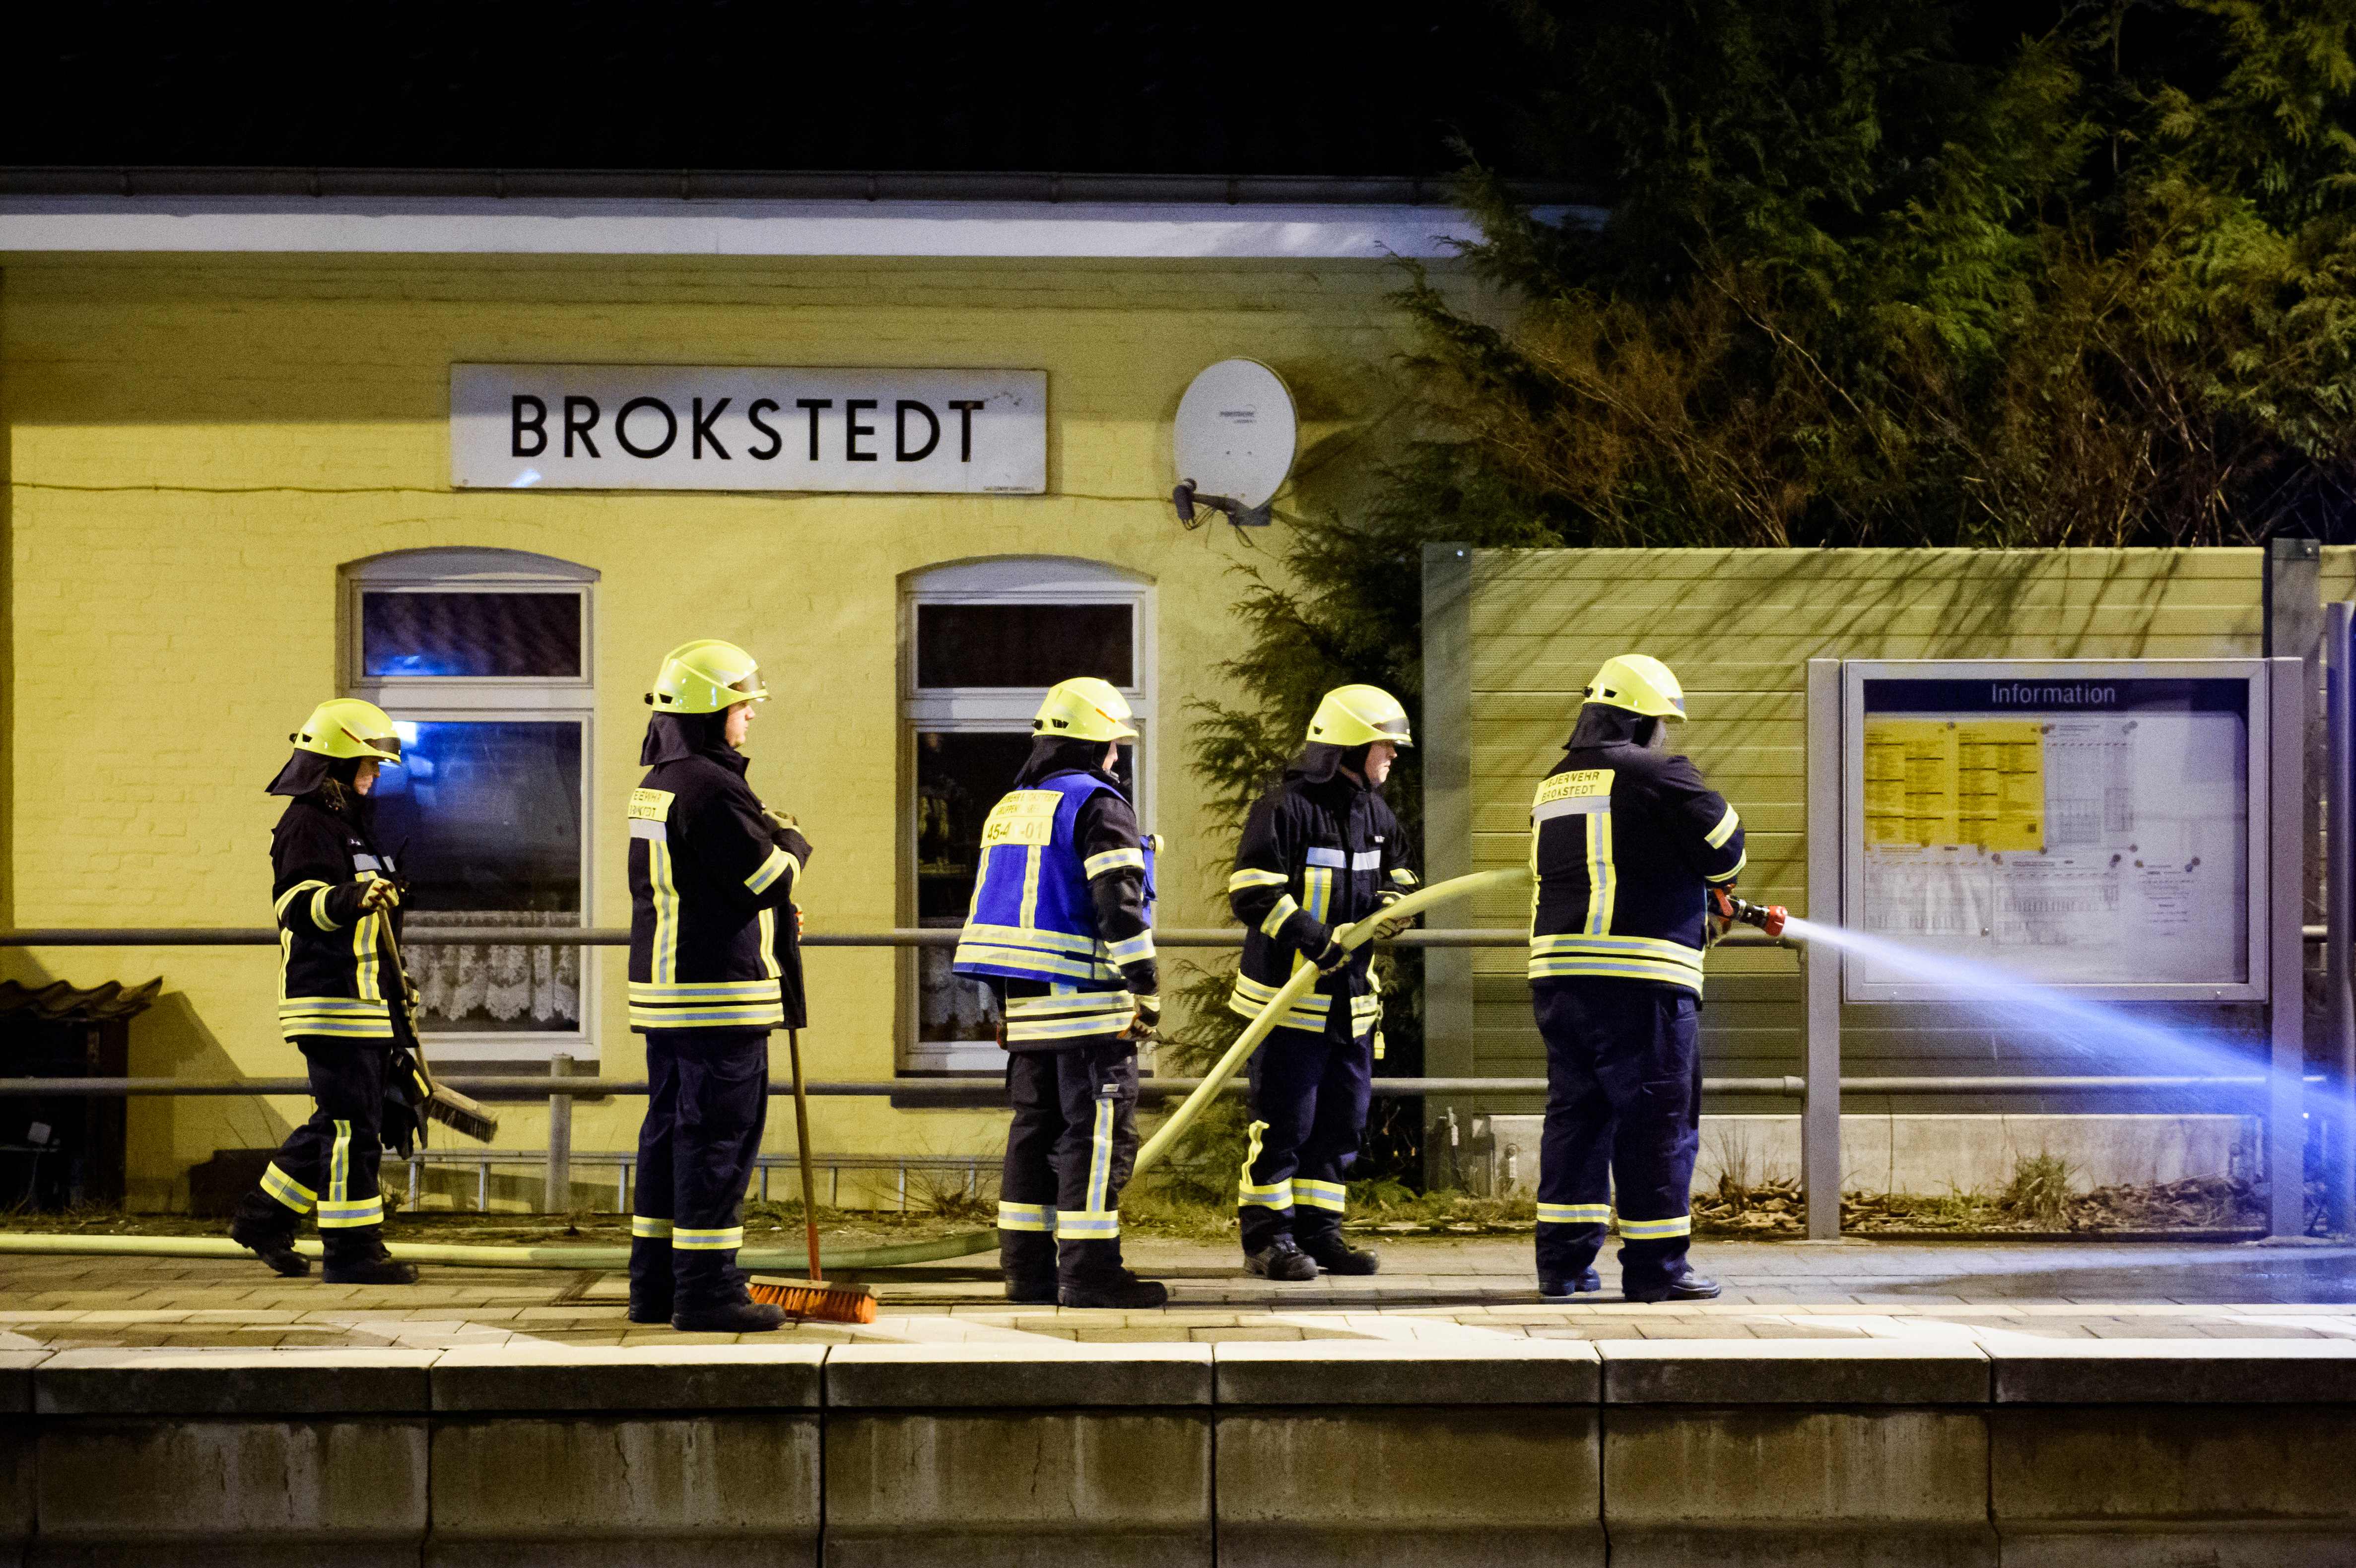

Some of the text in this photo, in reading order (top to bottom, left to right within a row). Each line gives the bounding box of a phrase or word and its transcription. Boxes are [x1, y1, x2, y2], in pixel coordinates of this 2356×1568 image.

[511, 394, 985, 463] BROKSTEDT
[1992, 683, 2116, 703] Information
[987, 821, 1043, 840] 45-4-01
